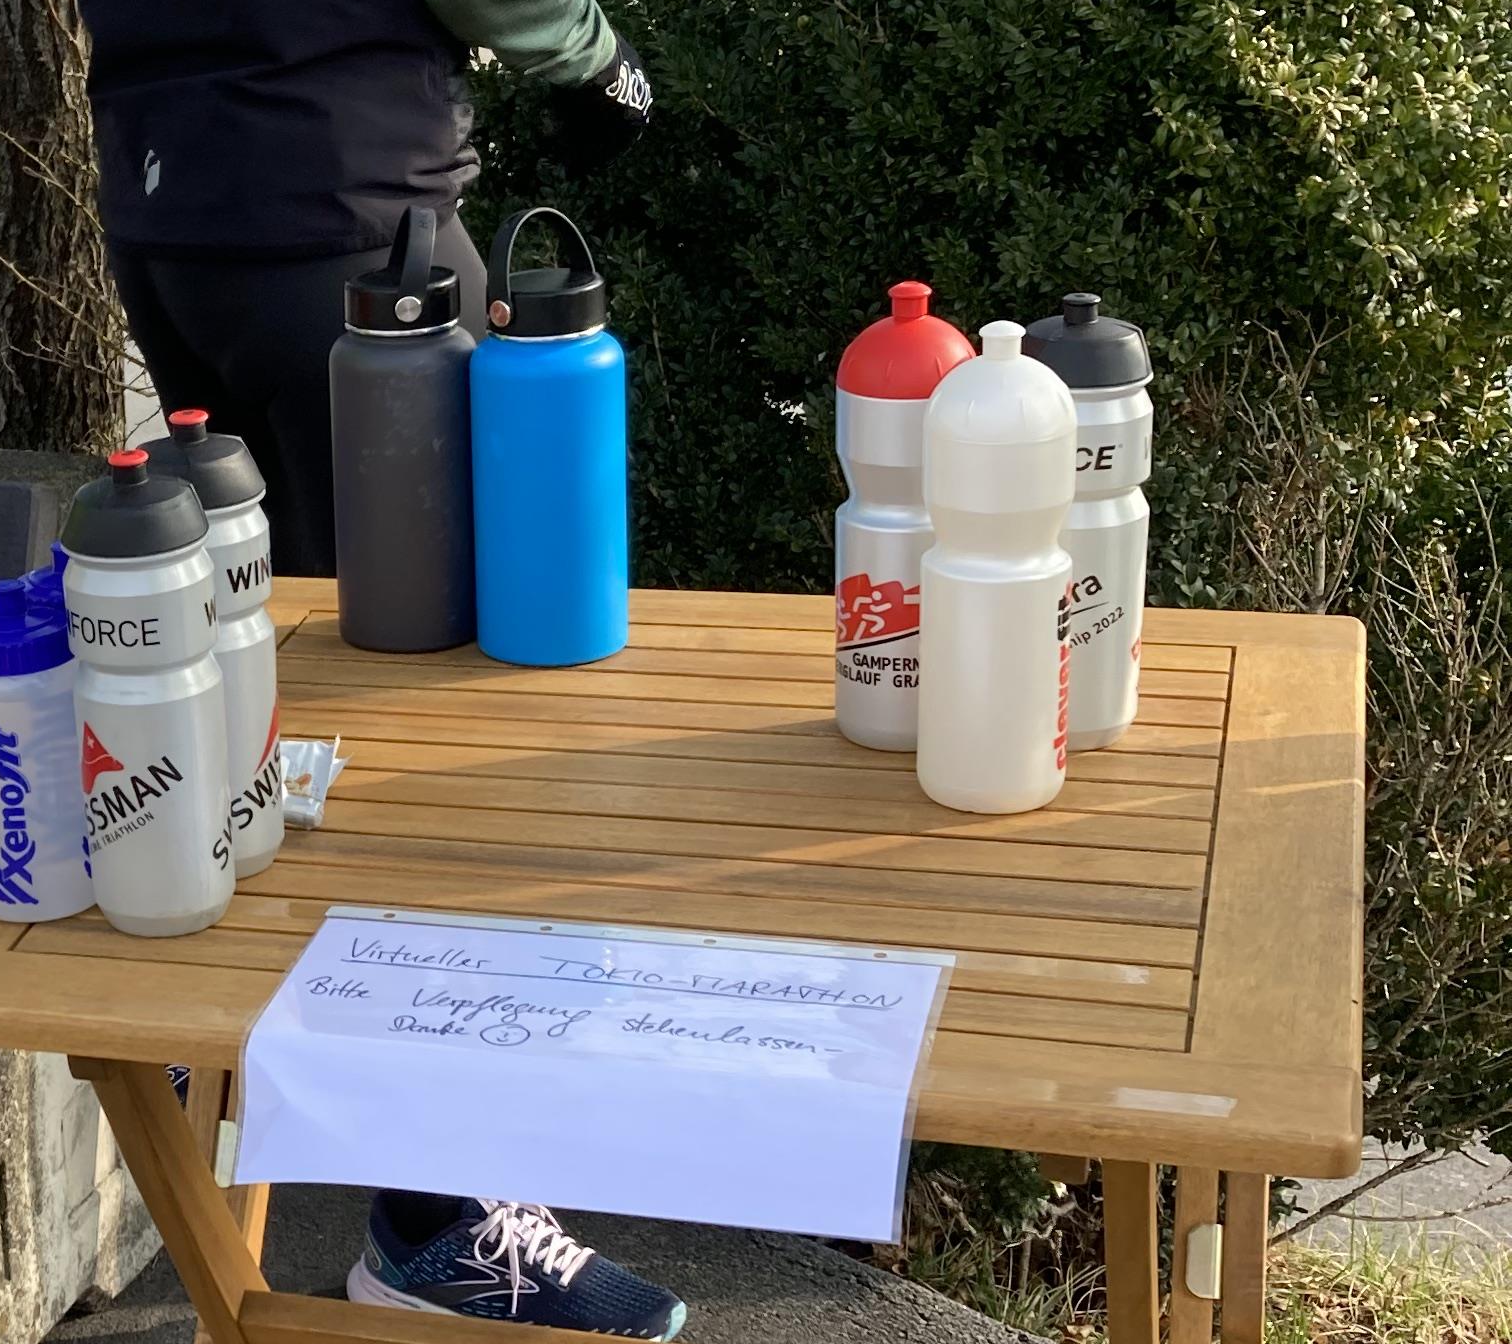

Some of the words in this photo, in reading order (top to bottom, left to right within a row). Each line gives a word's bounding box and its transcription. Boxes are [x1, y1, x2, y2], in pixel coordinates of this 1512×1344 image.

[1092, 606, 1125, 635] 2022
[350, 937, 492, 970] Virtueller
[305, 974, 373, 1000] Bitte
[411, 988, 592, 1038] Verpflegung
[387, 1015, 470, 1037] Danke
